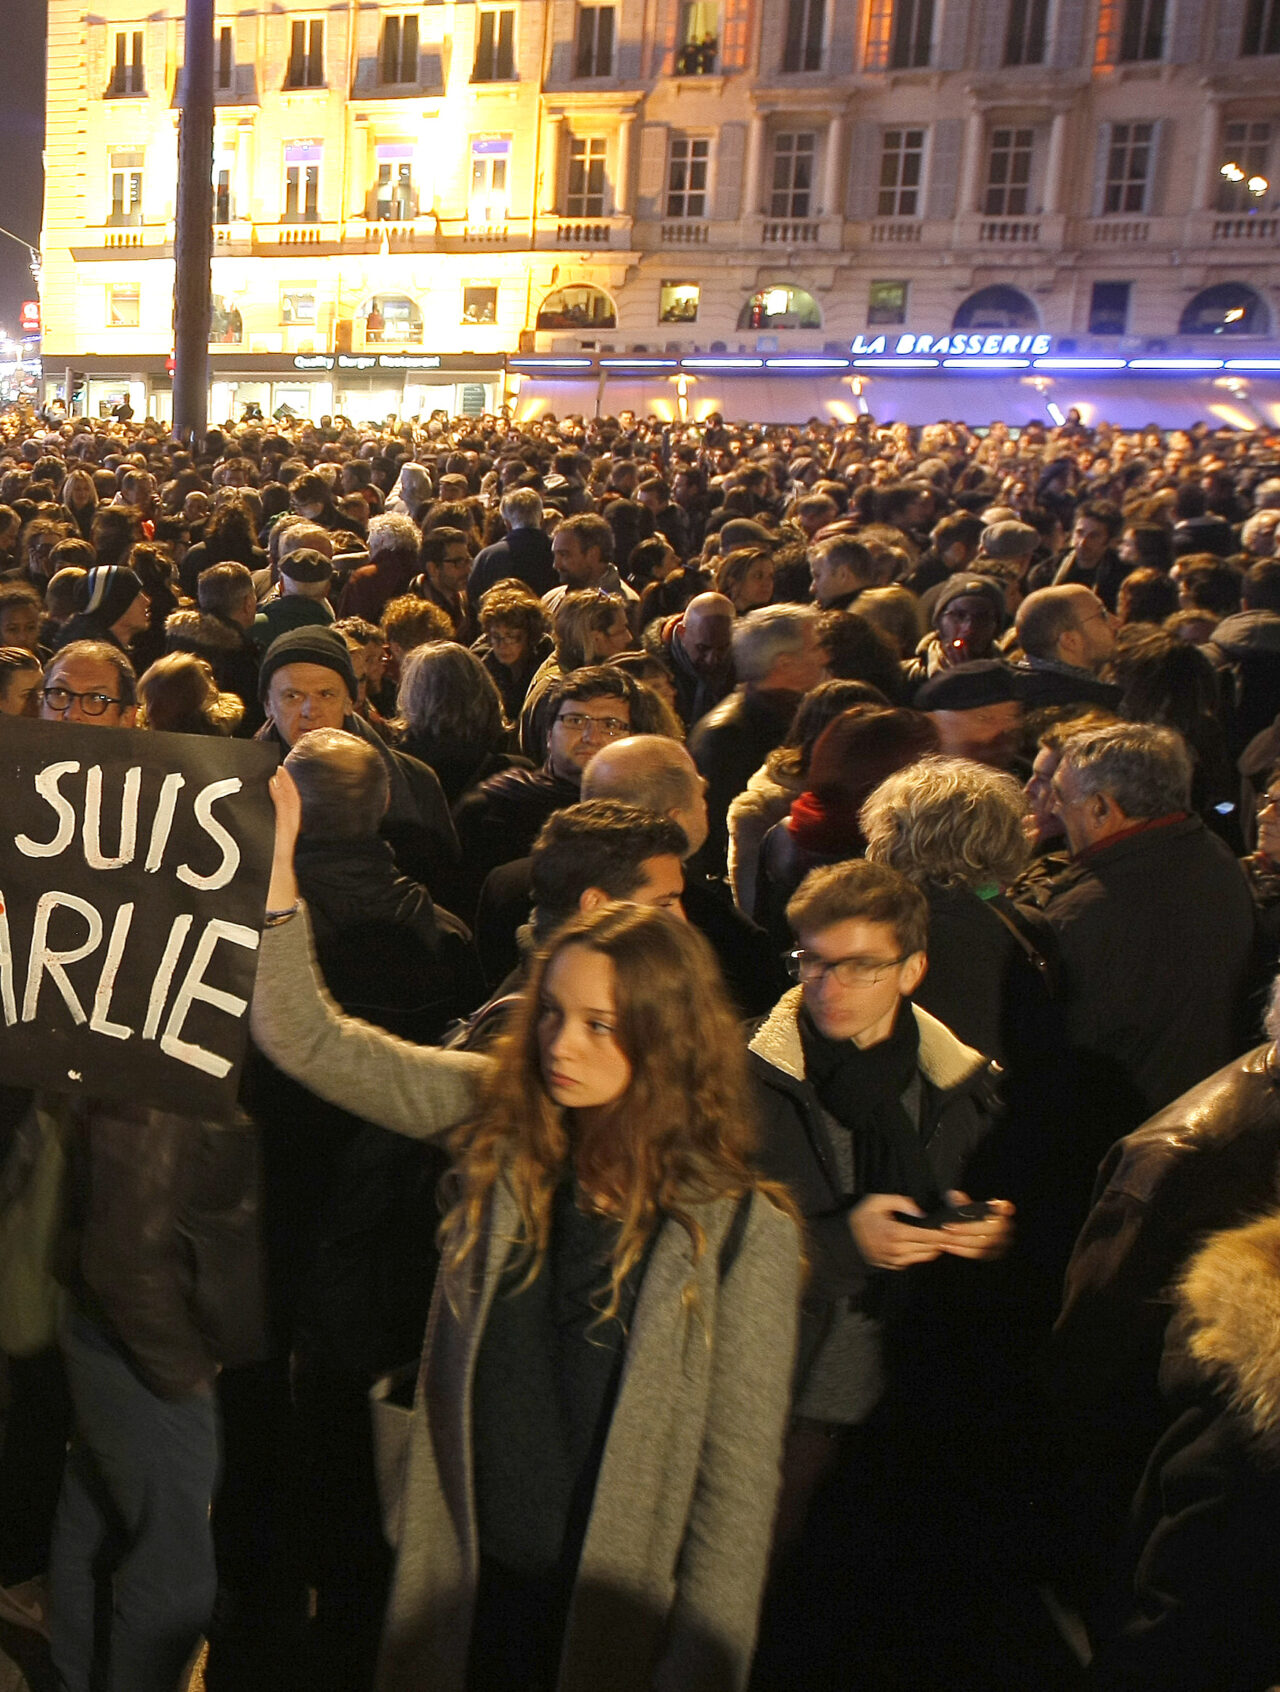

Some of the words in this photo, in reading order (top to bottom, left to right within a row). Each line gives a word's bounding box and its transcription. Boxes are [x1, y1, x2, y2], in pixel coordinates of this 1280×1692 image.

[851, 335, 886, 354] LA
[896, 334, 1052, 355] BRASSERIE
[15, 761, 242, 890] SUIS
